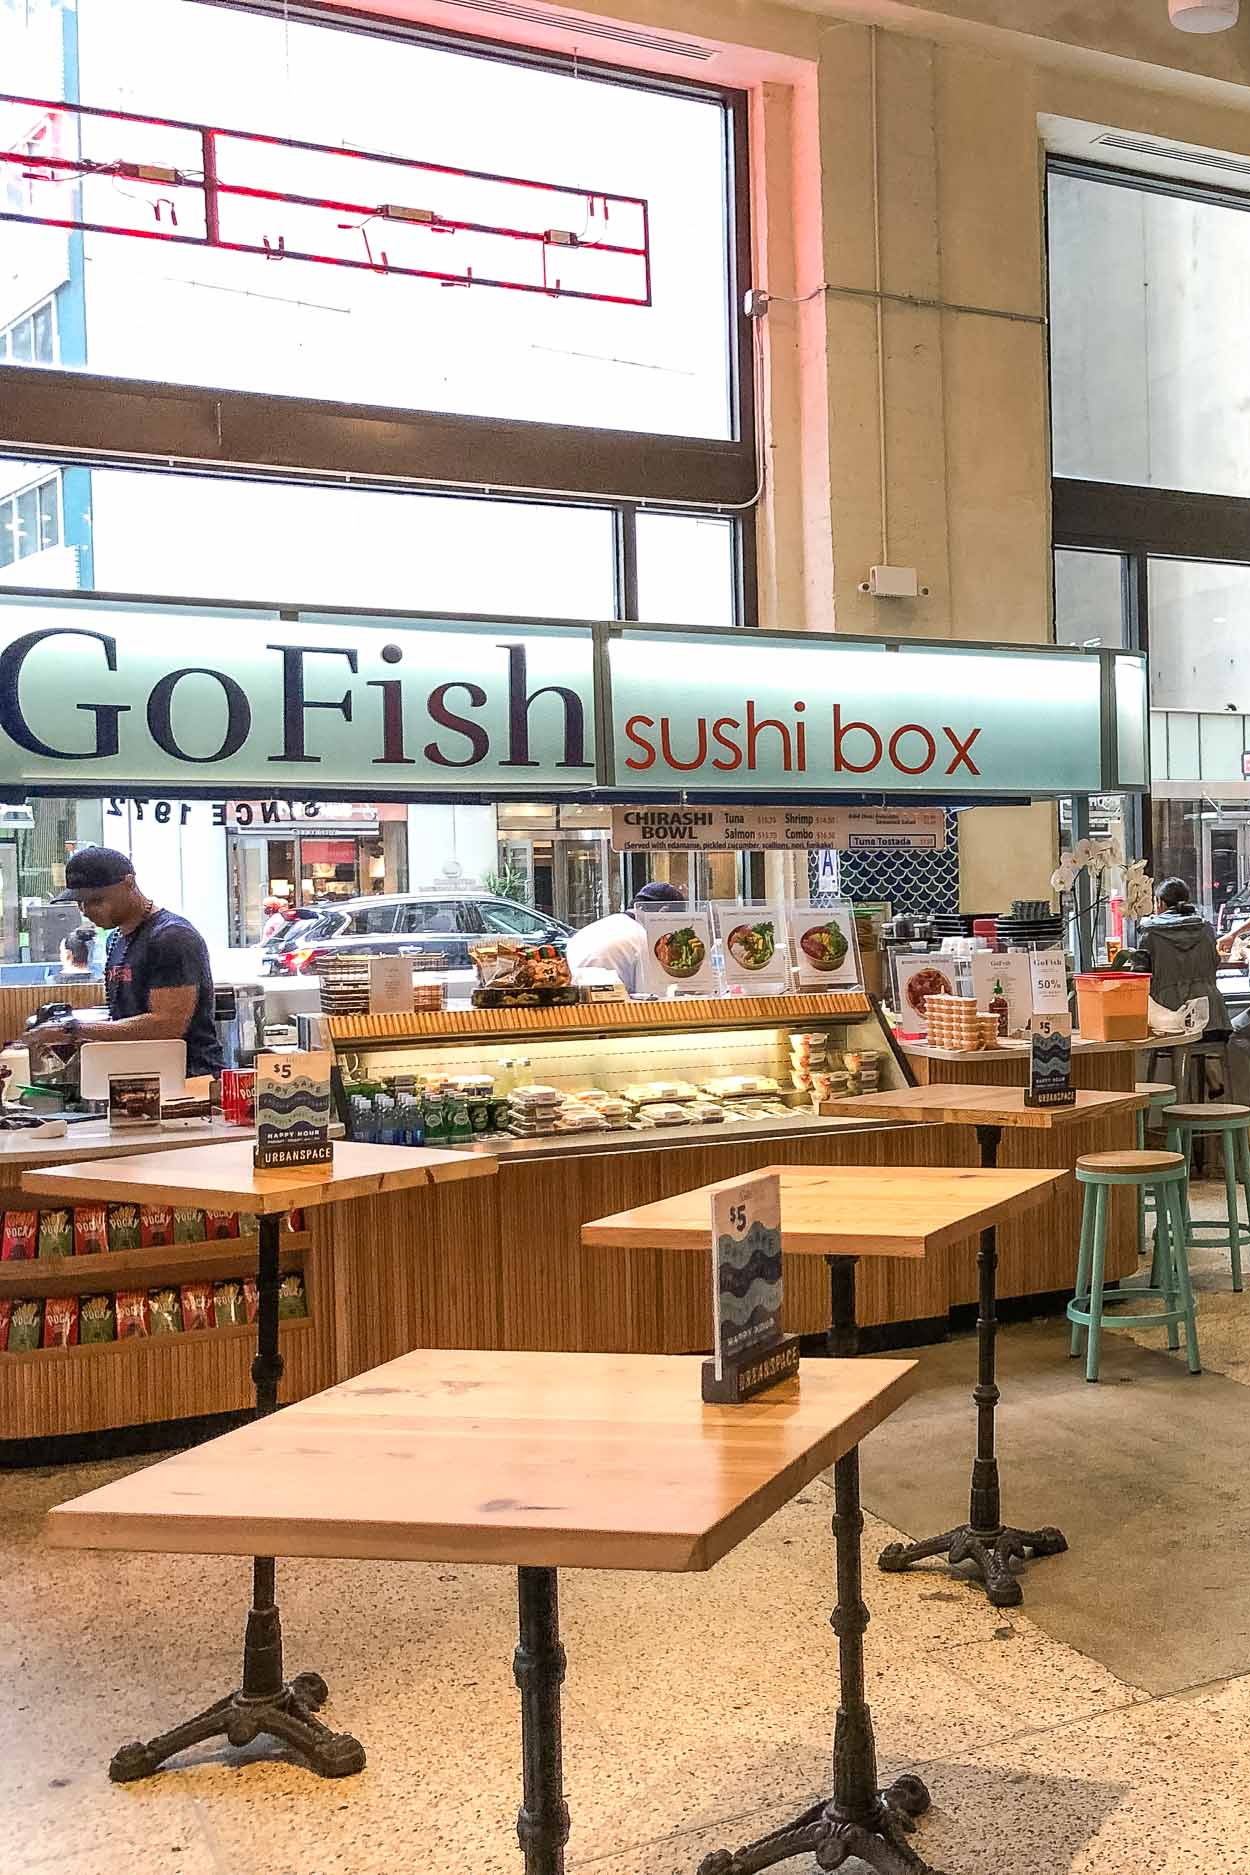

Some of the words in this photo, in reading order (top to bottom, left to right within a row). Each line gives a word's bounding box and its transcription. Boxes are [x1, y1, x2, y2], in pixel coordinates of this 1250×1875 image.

[0, 627, 594, 768] GoFish
[625, 700, 806, 771] sushi
[832, 703, 982, 775] box
[624, 811, 713, 826] CHIRASHI
[724, 813, 744, 824] Tuna
[785, 812, 813, 826] Shrimp
[642, 826, 698, 840] BOWL
[725, 828, 755, 839] Salmon
[785, 828, 813, 839] Combo
[651, 841, 666, 849] with
[854, 837, 875, 845] Tuna
[877, 837, 911, 845] Tostada
[822, 850, 834, 876] A
[1038, 979, 1061, 989] 50%
[1040, 1021, 1051, 1034] $5
[273, 1063, 292, 1078] $5
[267, 1131, 294, 1139] HAPPY
[297, 1129, 320, 1137] HOUR
[265, 1147, 331, 1163] URBANSPACE
[142, 1215, 171, 1227] POCKY
[174, 1212, 203, 1223] POCKY
[730, 1204, 746, 1232] $5
[109, 1218, 139, 1230] POCKY
[5, 1225, 35, 1239] POCKY
[81, 1310, 112, 1321] POCKY
